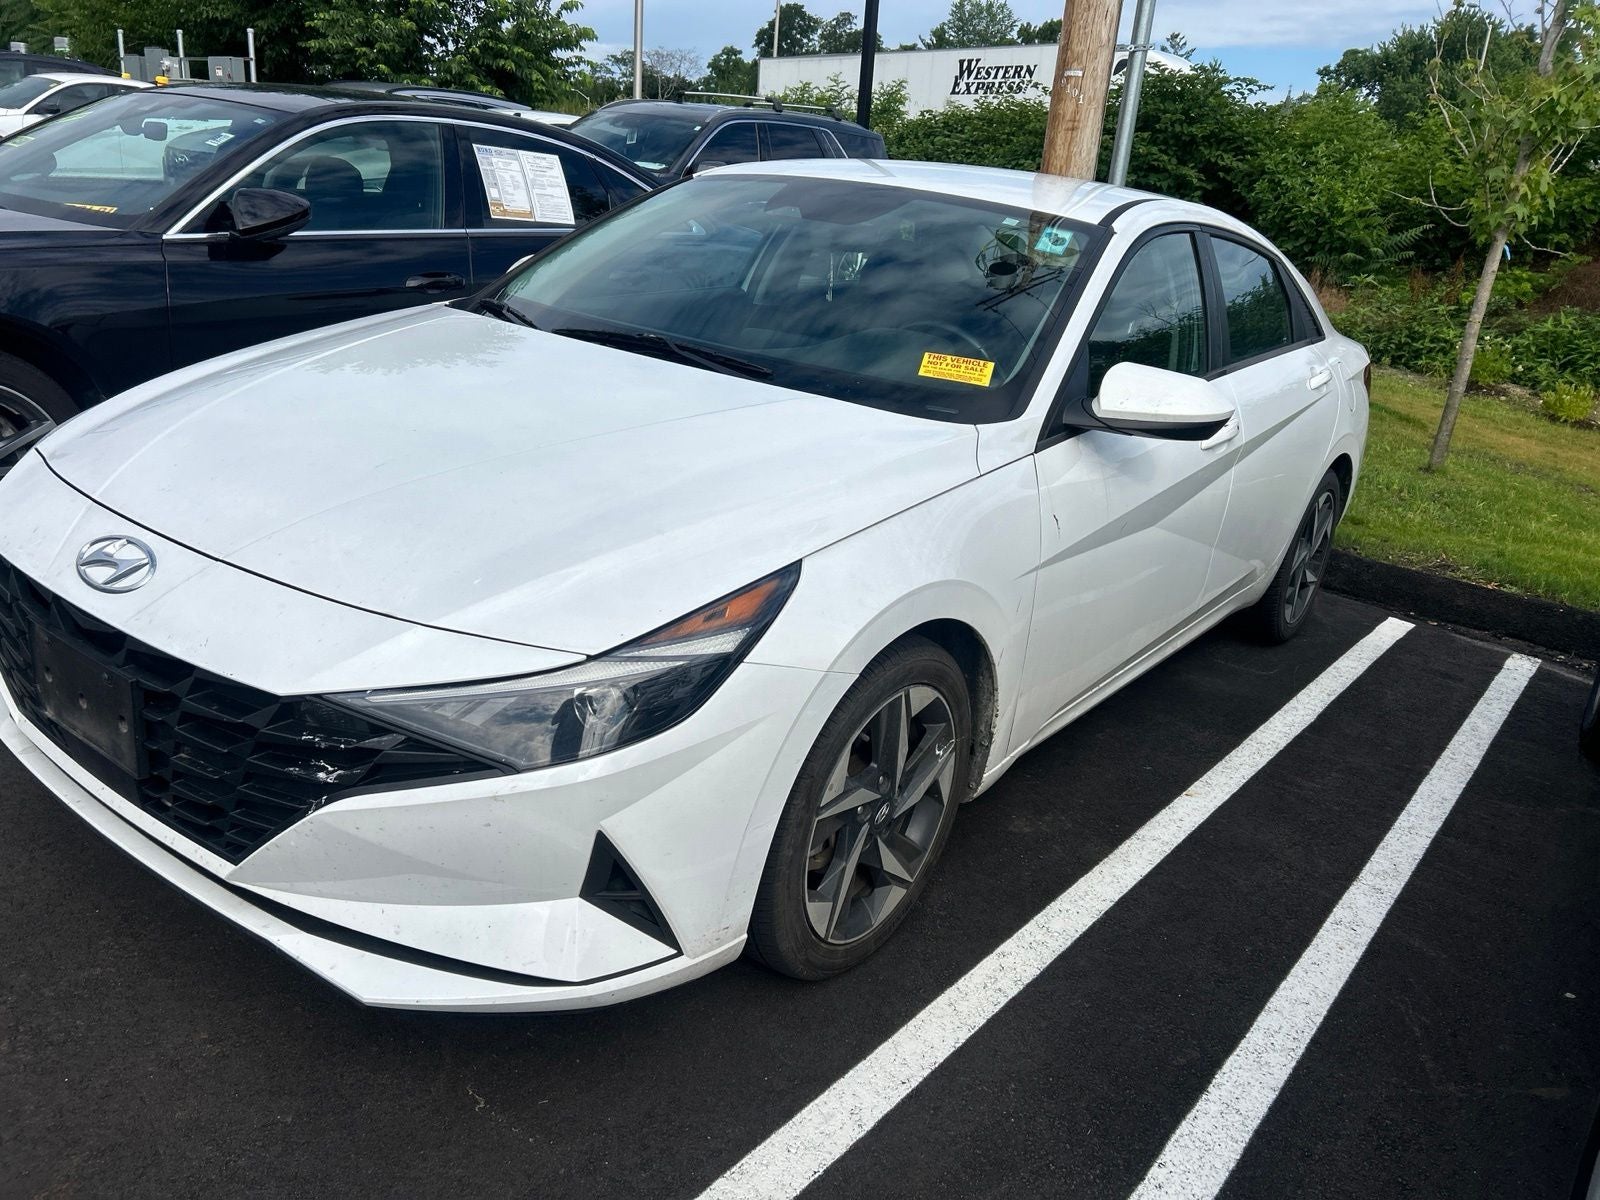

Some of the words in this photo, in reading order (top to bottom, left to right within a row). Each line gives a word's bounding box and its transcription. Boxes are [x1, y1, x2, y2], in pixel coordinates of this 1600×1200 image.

[958, 58, 1038, 81] WESTERN
[950, 75, 1025, 95] EXPRESS
[927, 354, 948, 362] THIS
[951, 357, 989, 368] VEHICLE
[964, 365, 985, 373] SALE
